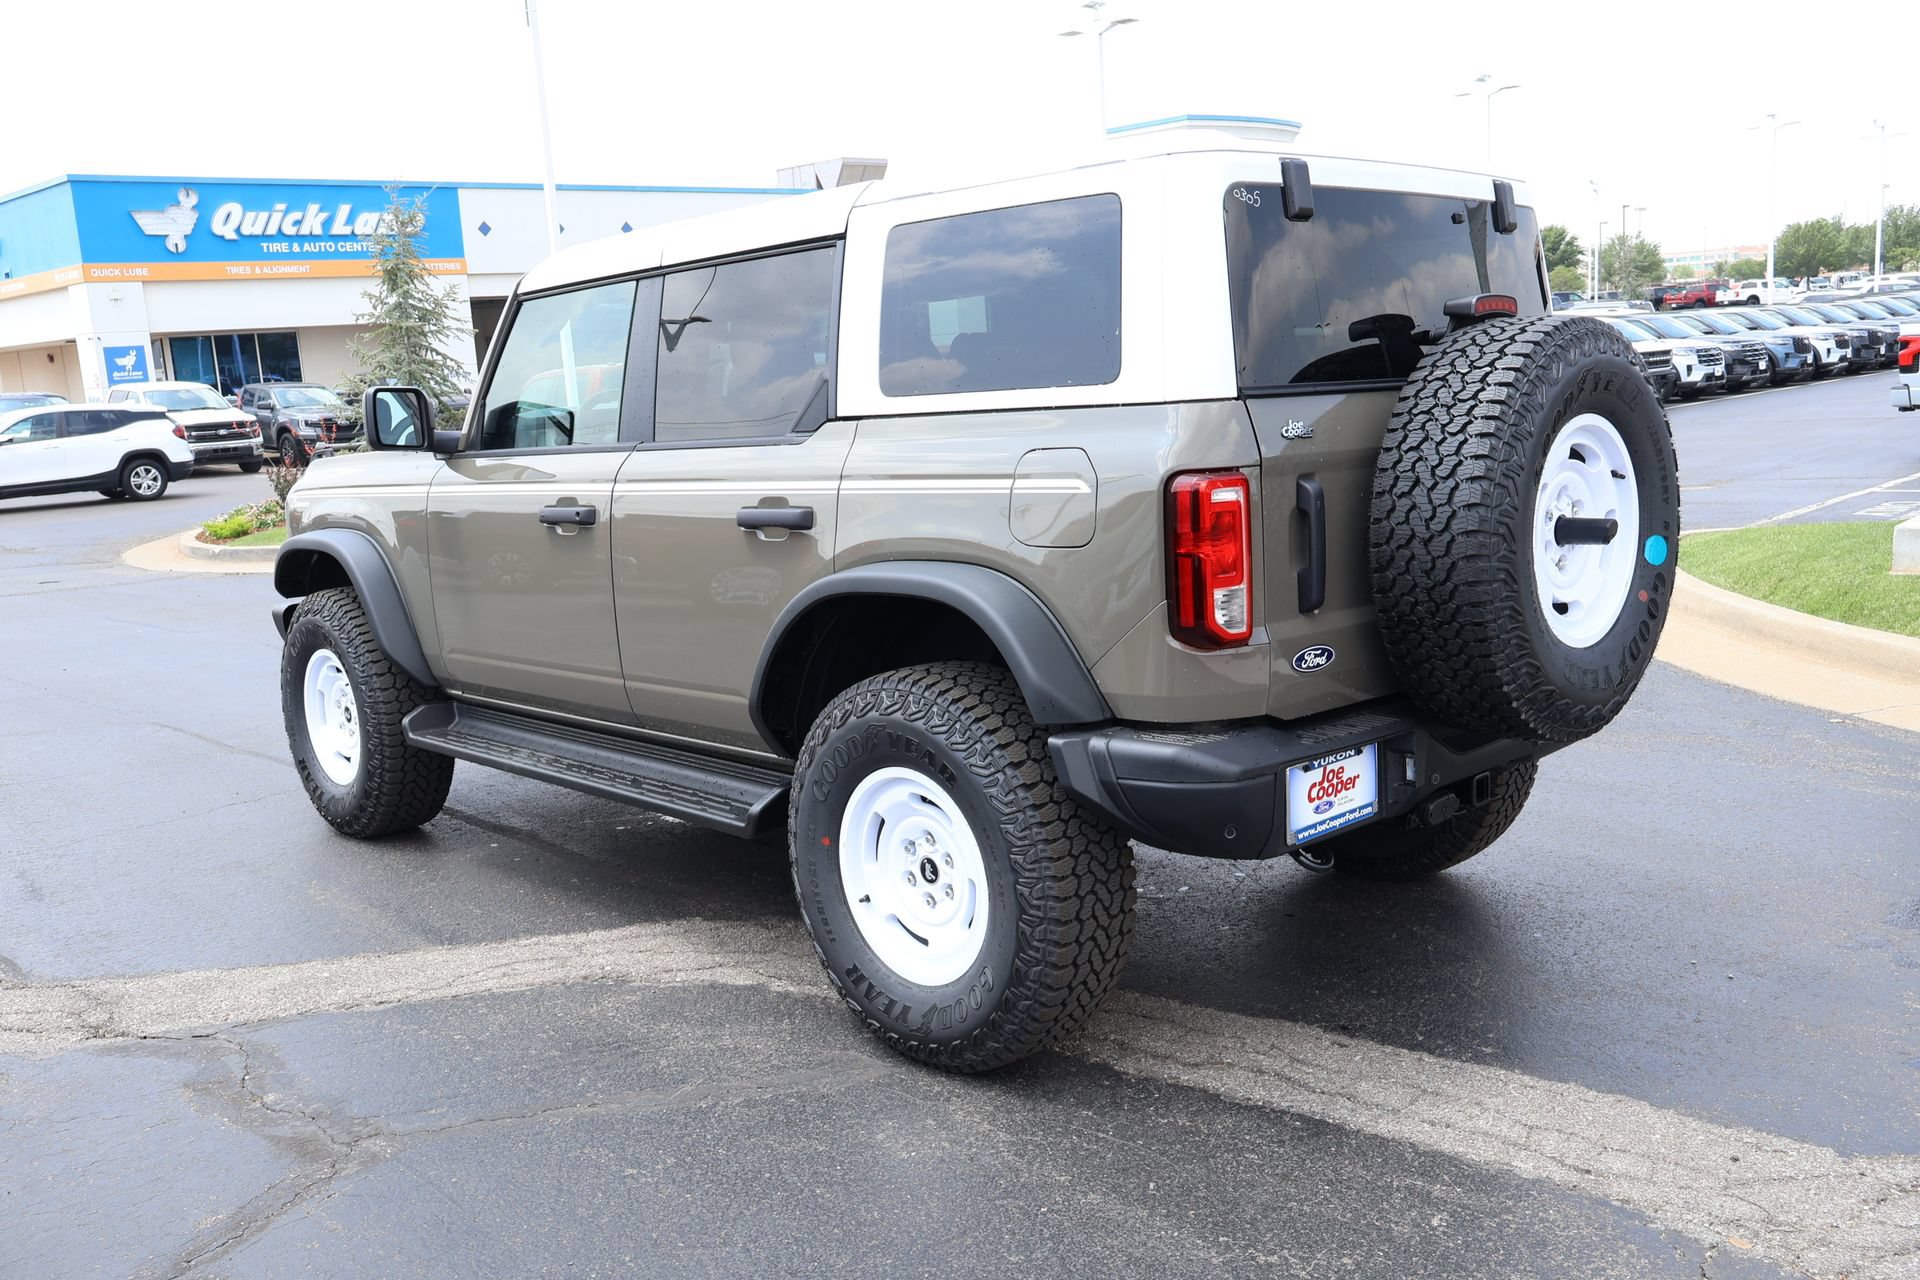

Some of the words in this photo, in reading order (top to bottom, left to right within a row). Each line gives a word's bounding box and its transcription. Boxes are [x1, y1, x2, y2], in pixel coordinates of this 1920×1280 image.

[1233, 187, 1260, 207] 0305
[211, 202, 330, 240] Quick
[261, 242, 289, 252] TIRE
[293, 242, 301, 252] &
[303, 242, 334, 252] AUTO
[90, 268, 121, 277] QUICK
[123, 267, 149, 276] LUBE
[225, 266, 251, 274] TIRES
[255, 266, 261, 274] &
[262, 265, 311, 274] ALIGNMENT
[419, 262, 462, 270] ATTERIES
[1287, 419, 1304, 429] Joe
[1301, 649, 1328, 669] Ford
[812, 724, 958, 802] GOODYEAR
[1312, 748, 1356, 769] YUKON
[1317, 765, 1345, 787] Joe
[1307, 774, 1360, 803] Cooper
[845, 963, 995, 1035] GOODYEAR
